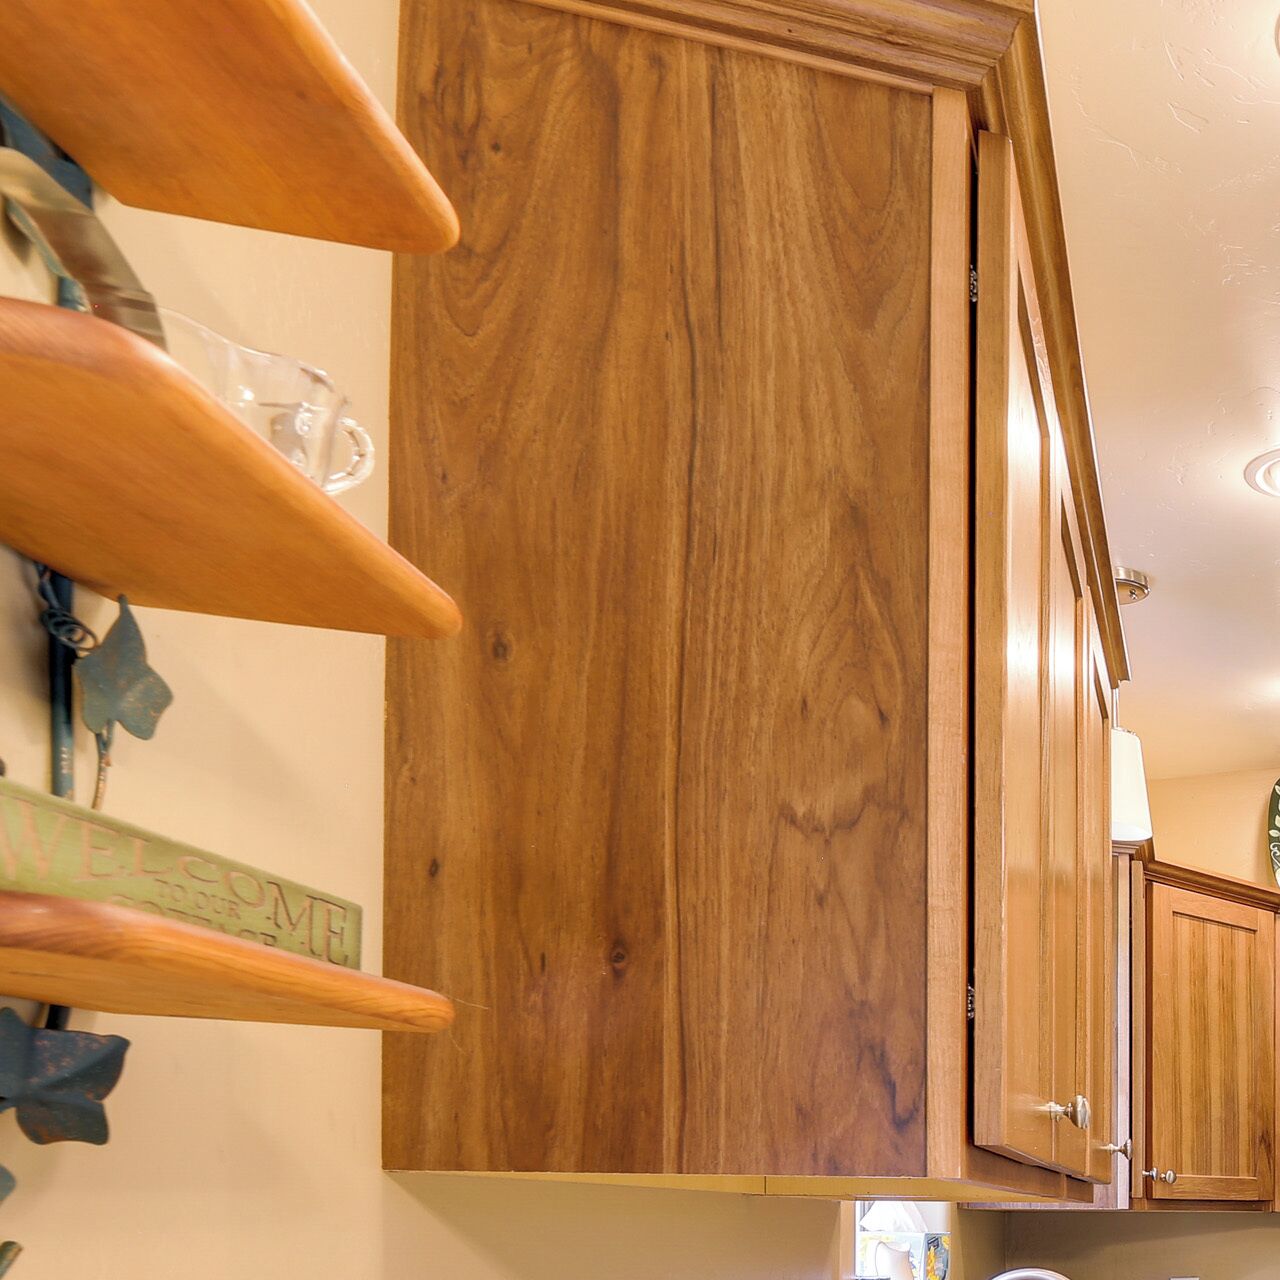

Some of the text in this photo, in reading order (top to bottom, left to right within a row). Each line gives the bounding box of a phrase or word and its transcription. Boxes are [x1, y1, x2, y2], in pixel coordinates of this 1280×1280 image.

[0, 798, 353, 966] WELCOME
[154, 878, 242, 920] TO OUR
